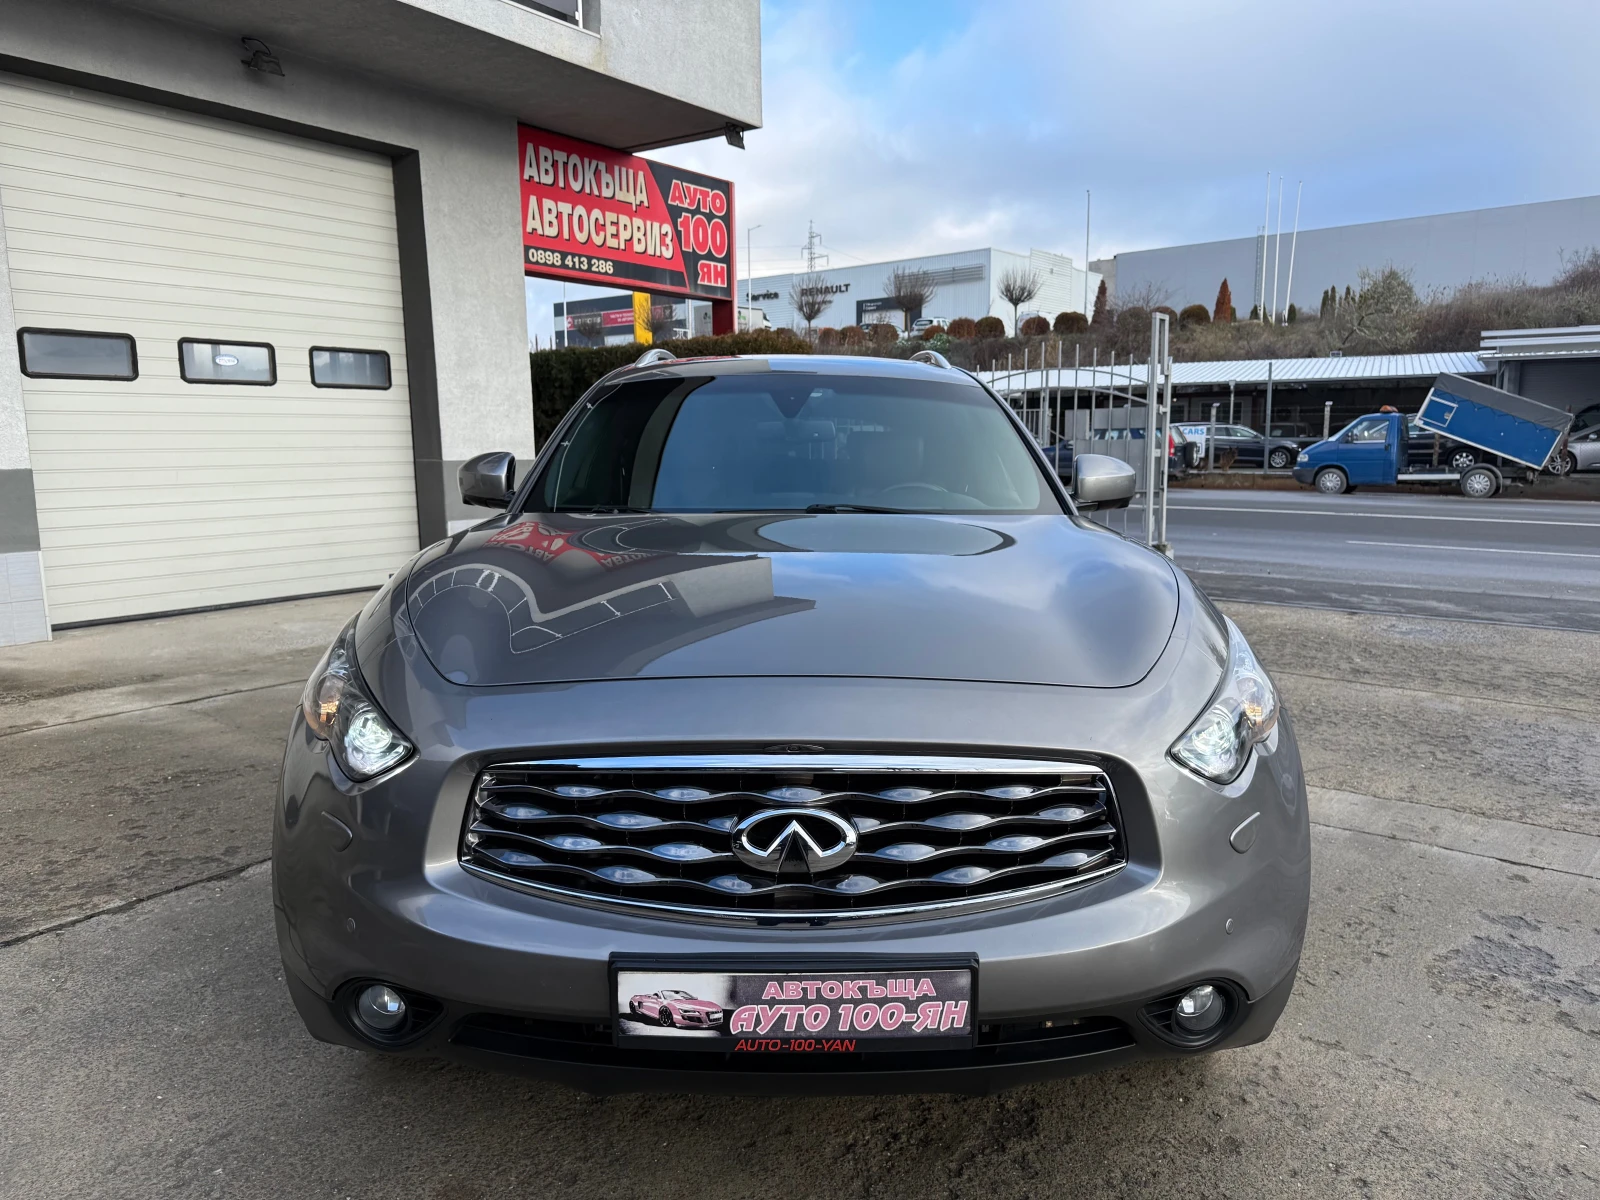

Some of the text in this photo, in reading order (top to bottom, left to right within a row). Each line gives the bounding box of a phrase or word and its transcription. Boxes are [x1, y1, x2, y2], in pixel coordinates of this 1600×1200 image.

[523, 142, 649, 211] АВТОКЪЩА
[668, 179, 727, 216] АУТО
[526, 195, 674, 259] АВТОСЕРВИЗ
[677, 212, 728, 258] 100
[528, 248, 614, 274] 0898 413 286
[697, 260, 727, 288] ЯН
[801, 283, 850, 297] RENAULT
[762, 979, 936, 1000] АВТОКЪЩА
[730, 1001, 968, 1034] АУТО 100-ЯН
[735, 1039, 856, 1051] AUTO-100-YAN
